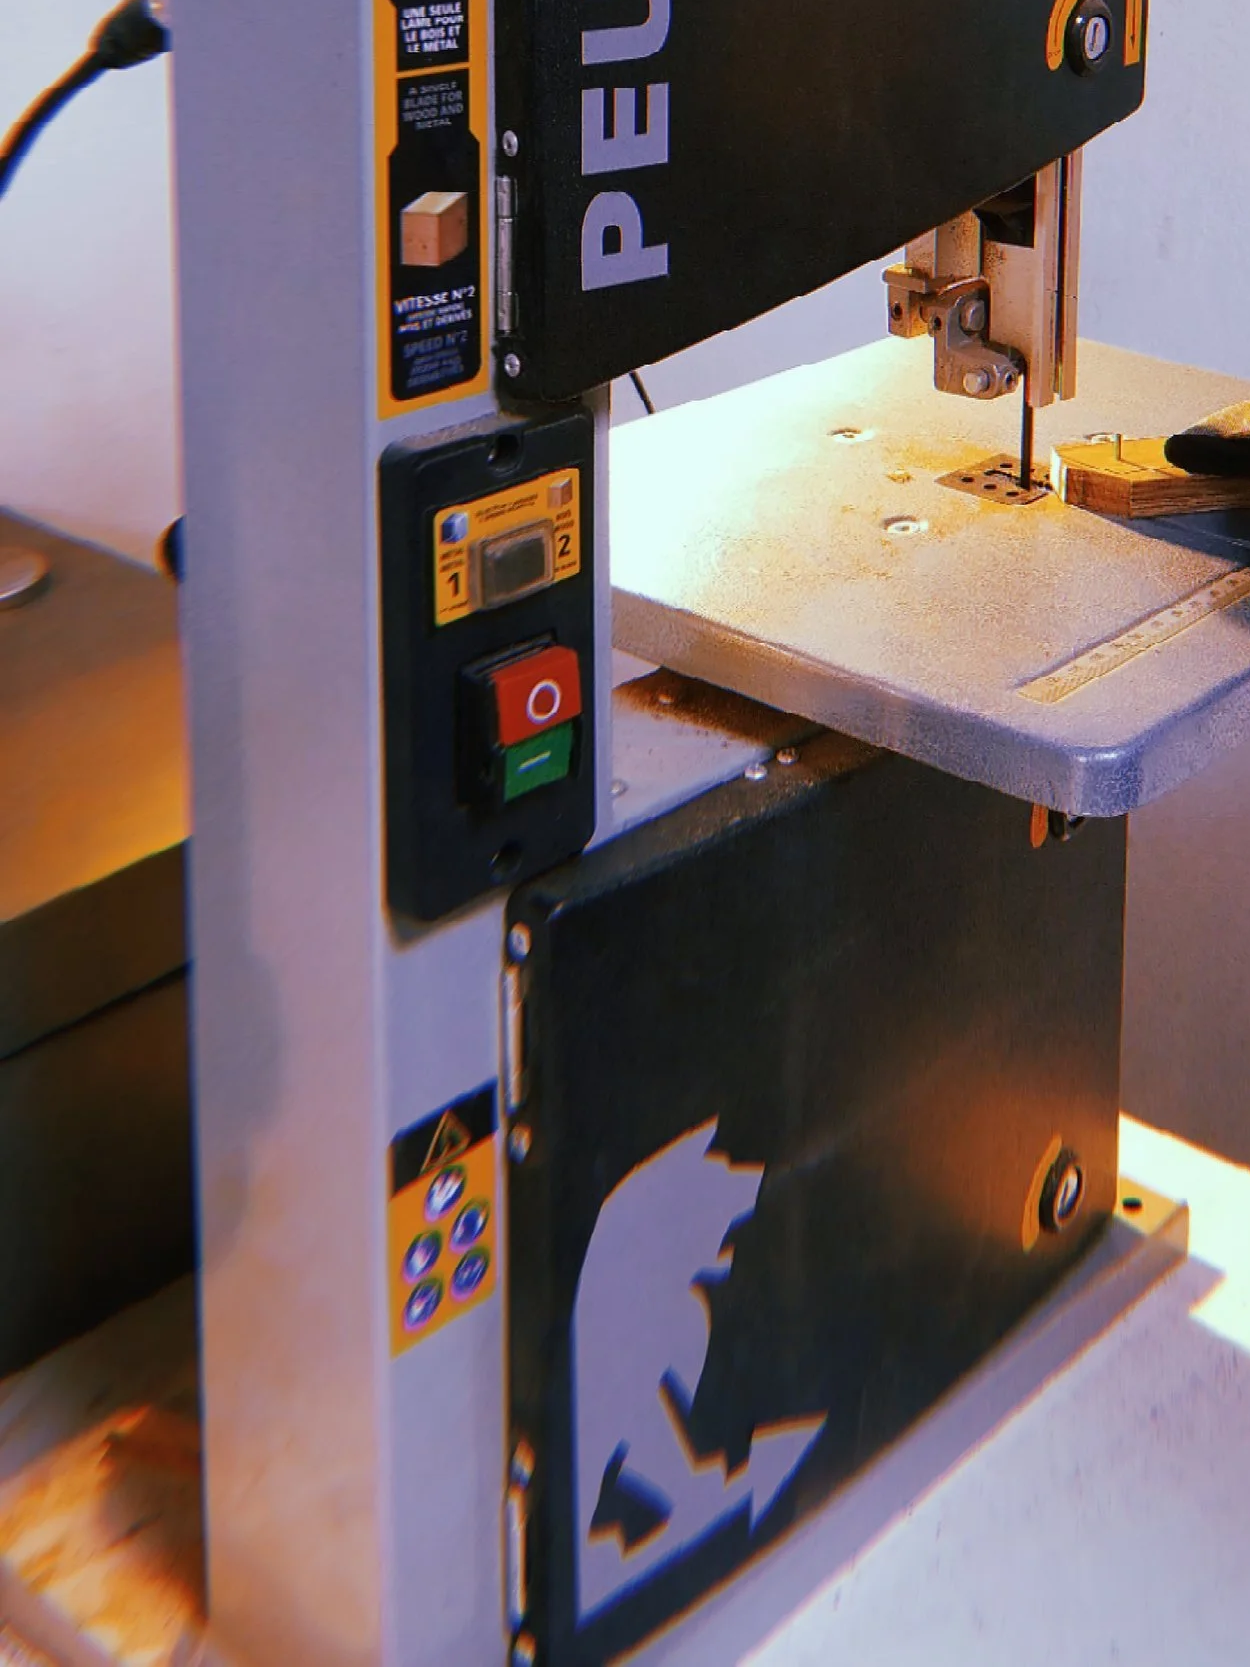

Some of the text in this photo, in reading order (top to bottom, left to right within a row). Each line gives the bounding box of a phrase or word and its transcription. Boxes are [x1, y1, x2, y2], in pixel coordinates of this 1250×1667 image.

[429, 1, 461, 16] SEULE
[401, 15, 464, 31] LAME POUR
[420, 26, 446, 40] BOIS
[448, 24, 461, 37] ET
[406, 42, 420, 53] LE
[441, 90, 463, 104] FOR
[440, 102, 464, 116] AND
[393, 292, 449, 314] VITESSE
[558, 534, 571, 559] 2
[446, 572, 460, 598] 1
